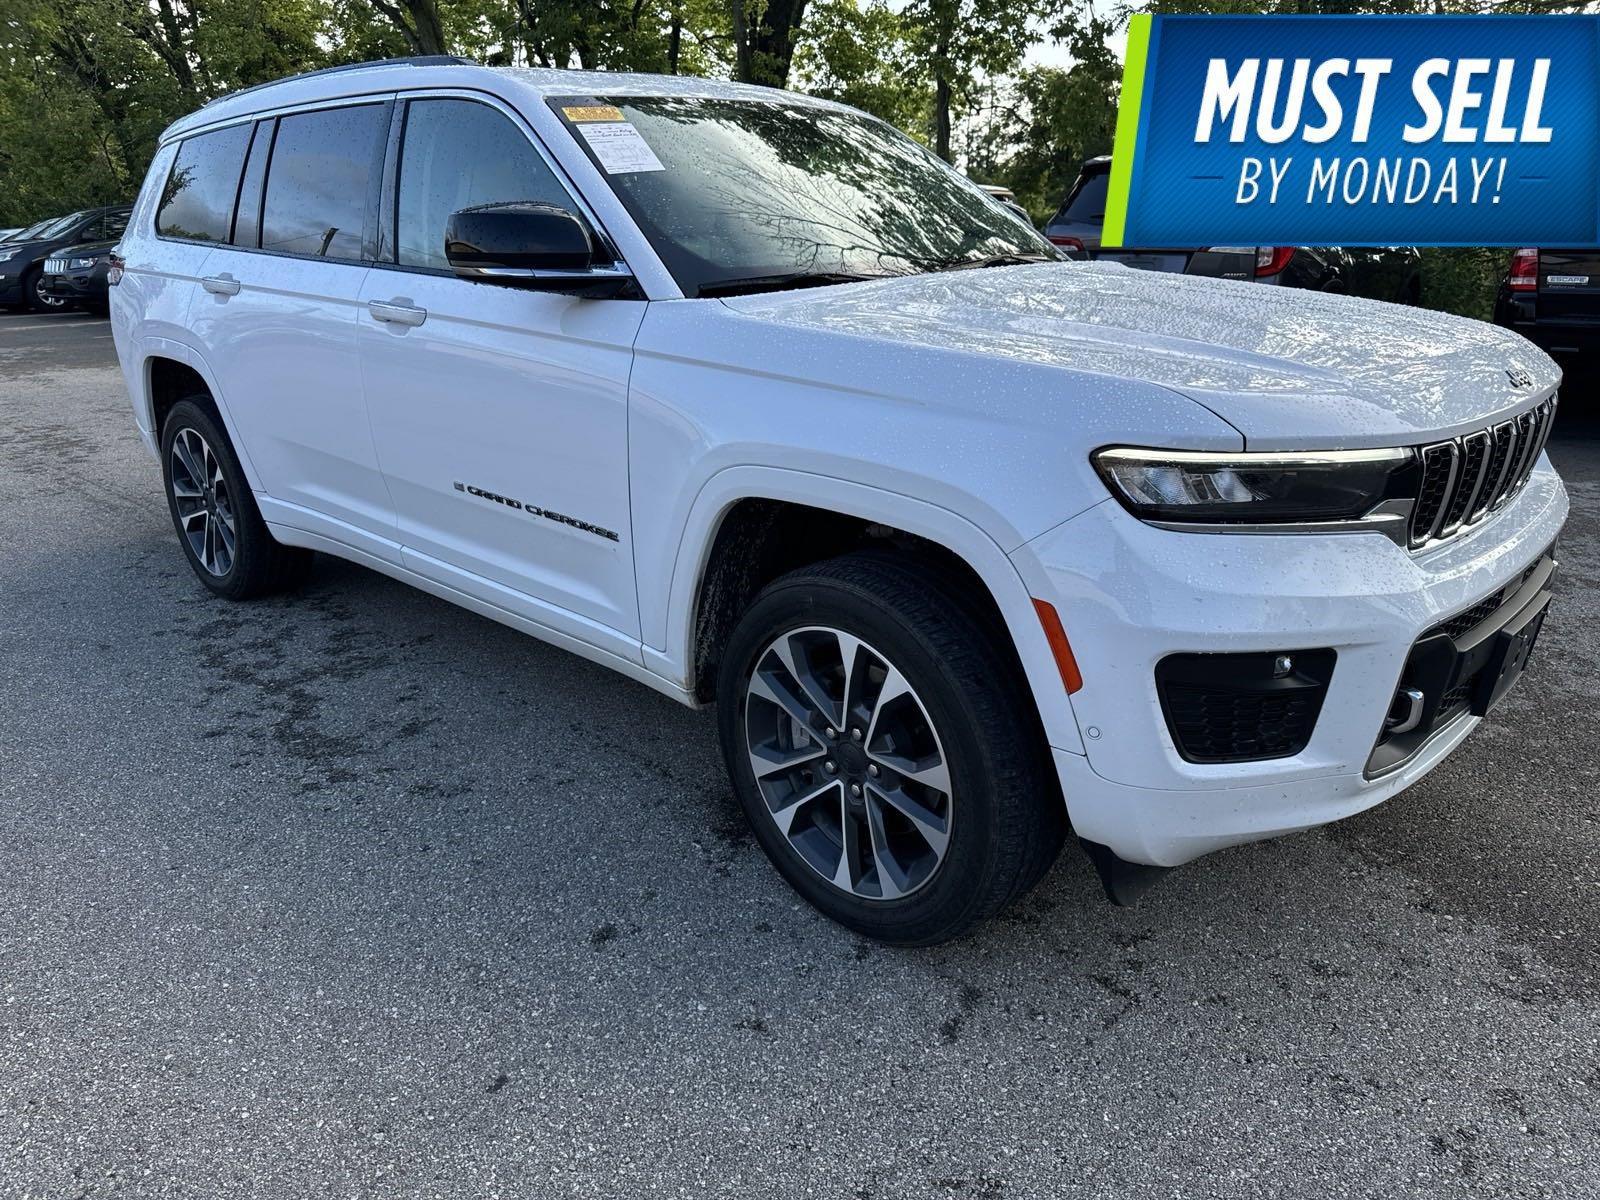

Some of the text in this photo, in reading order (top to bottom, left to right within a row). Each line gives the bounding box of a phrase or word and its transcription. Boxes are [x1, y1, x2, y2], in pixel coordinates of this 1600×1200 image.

[1549, 275, 1588, 283] ESCAPE
[467, 485, 620, 543] GRAND CHEROKEE
